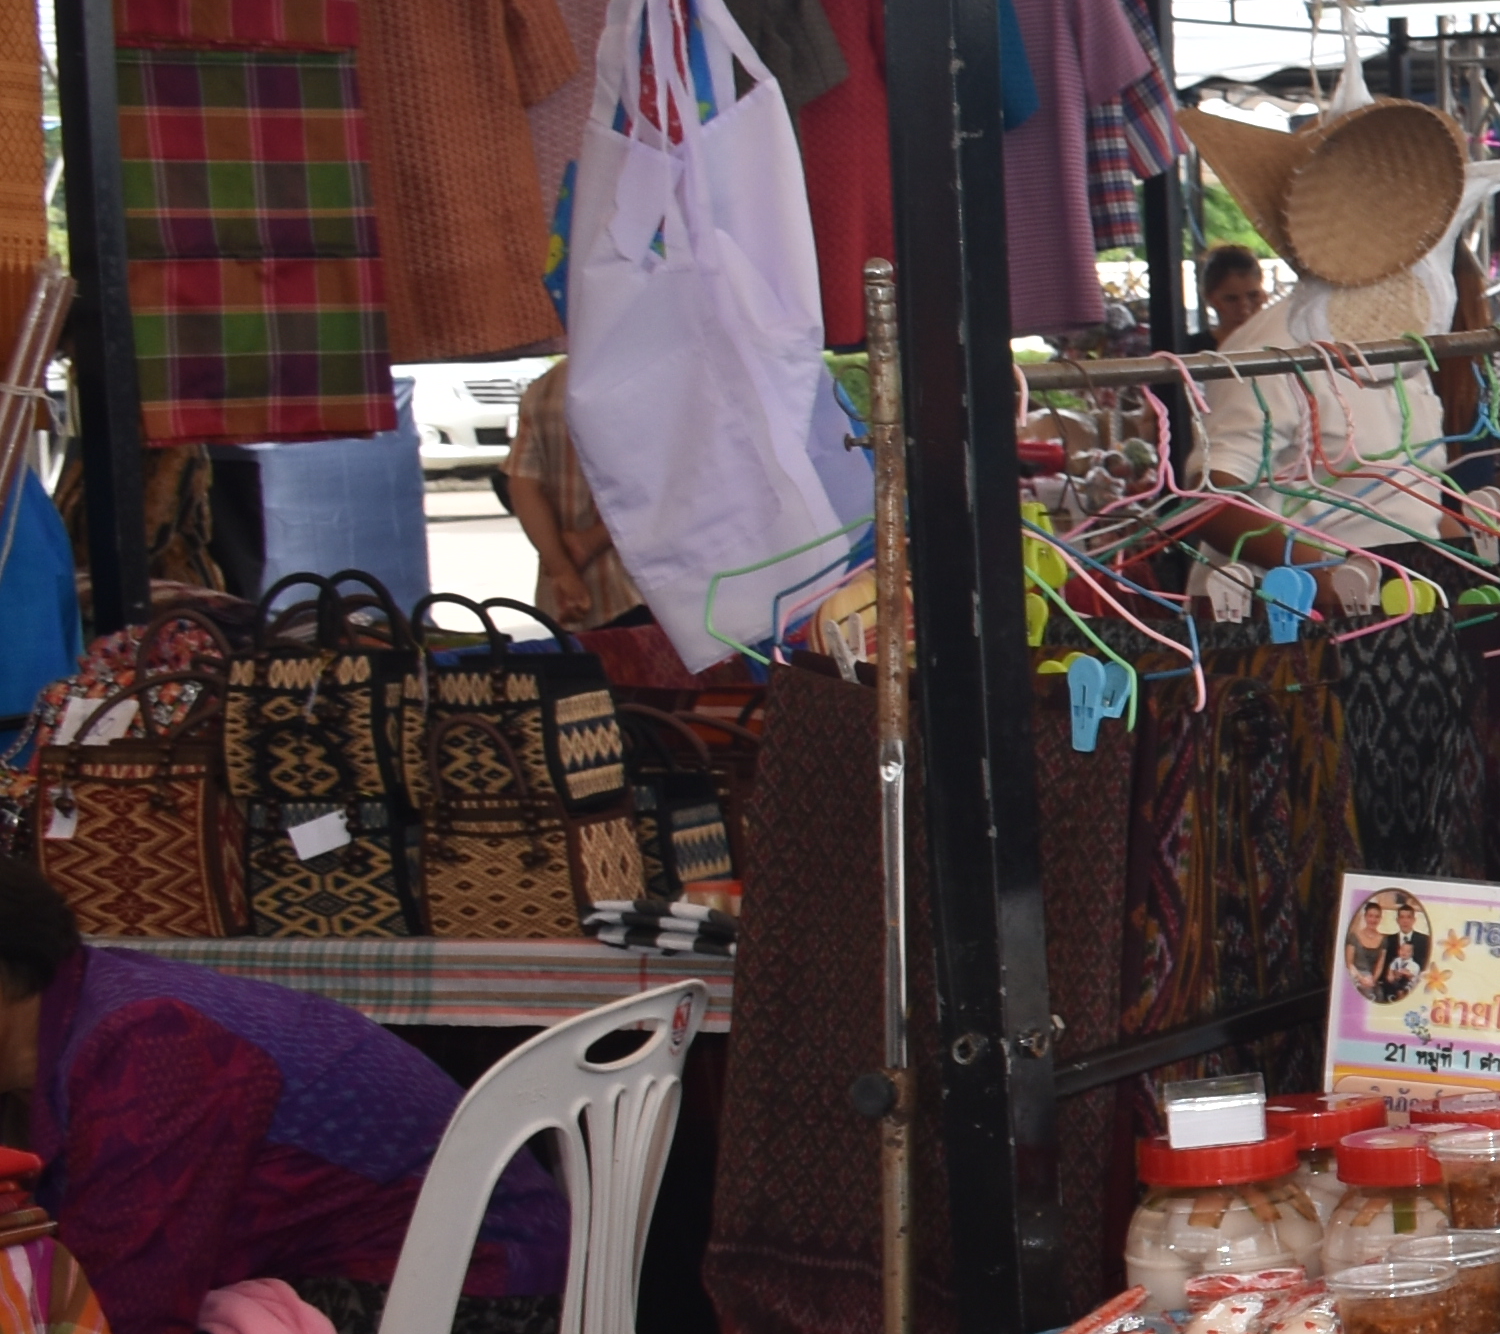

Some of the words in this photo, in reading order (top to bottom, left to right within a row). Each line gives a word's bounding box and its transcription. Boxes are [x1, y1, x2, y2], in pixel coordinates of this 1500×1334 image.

[1384, 1042, 1406, 1062] 21
[1416, 1042, 1453, 1072] หมู่ที่
[1462, 1049, 1470, 1069] 1
